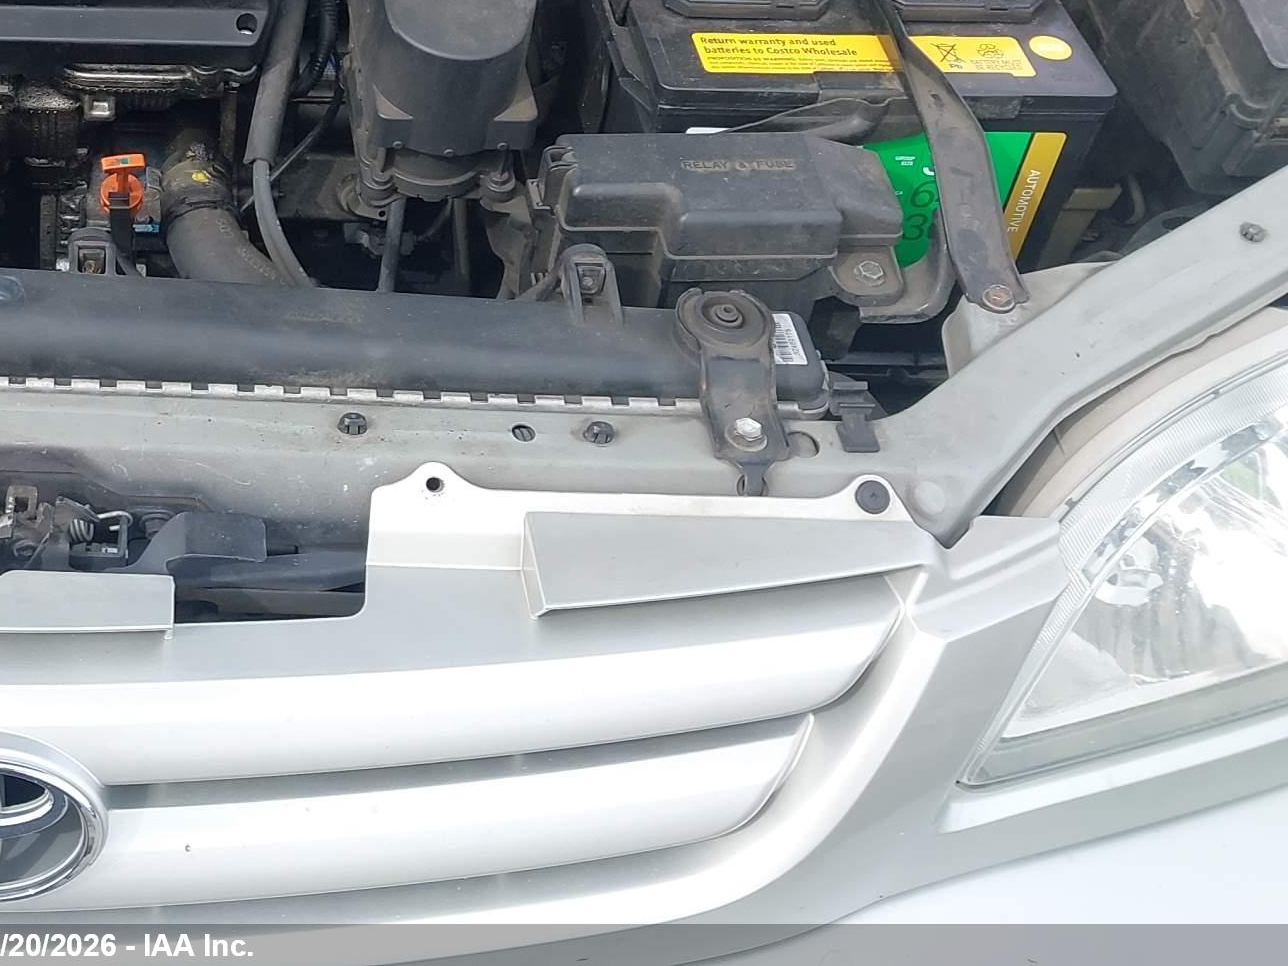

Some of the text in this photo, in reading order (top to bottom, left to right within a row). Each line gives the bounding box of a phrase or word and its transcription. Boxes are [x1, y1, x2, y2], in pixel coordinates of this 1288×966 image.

[700, 36, 837, 47] Return warranty and used
[704, 46, 858, 57] batteries to Costco Wholesale
[681, 160, 729, 171] RELAY
[1006, 169, 1041, 233] AUTOMOTIVE
